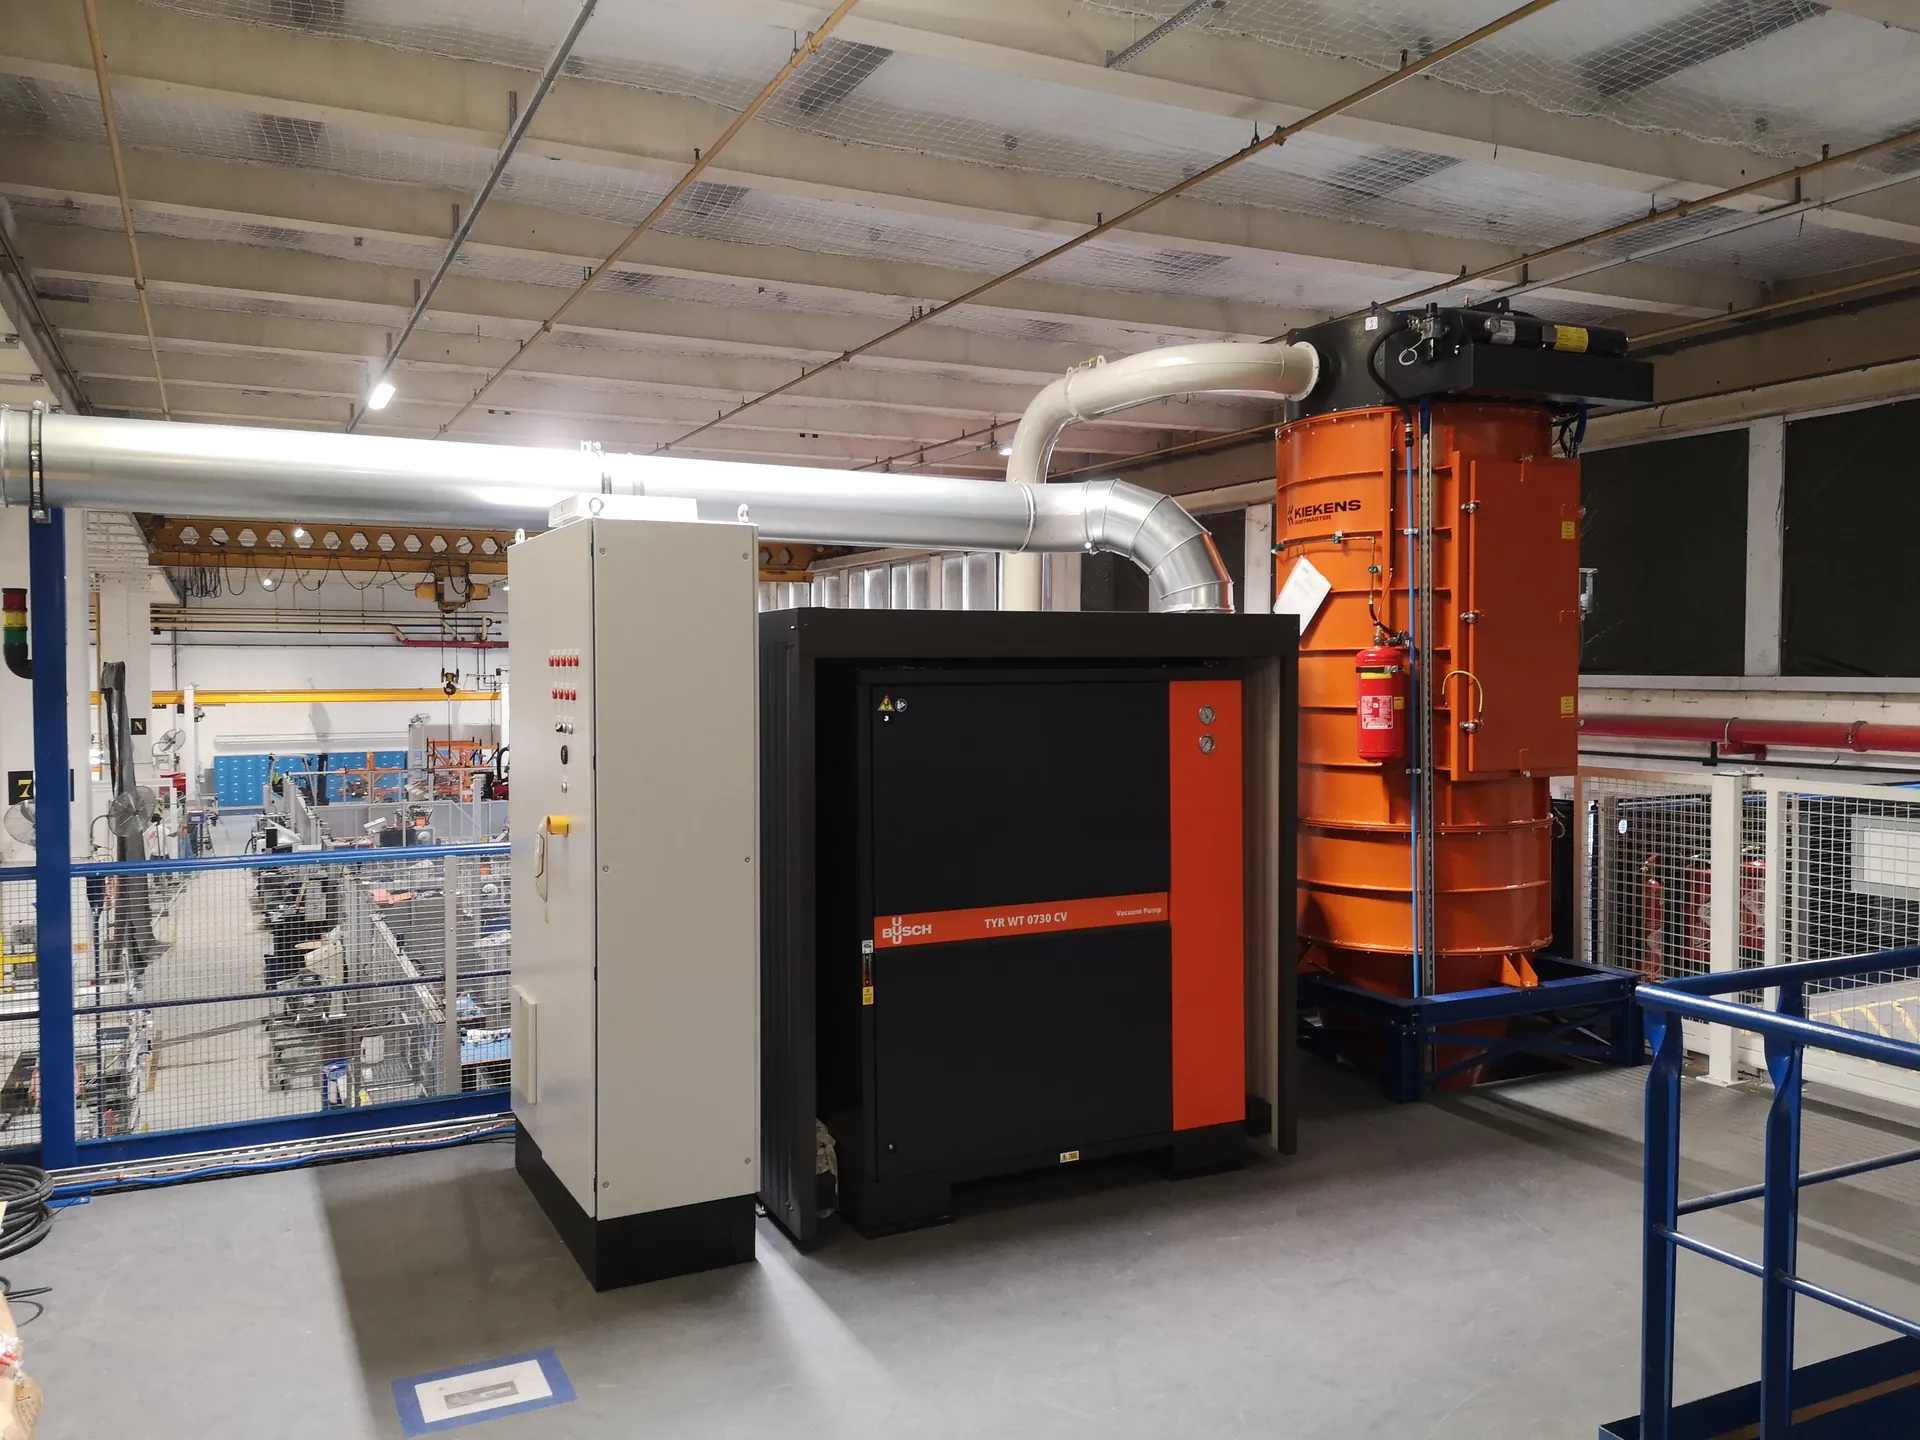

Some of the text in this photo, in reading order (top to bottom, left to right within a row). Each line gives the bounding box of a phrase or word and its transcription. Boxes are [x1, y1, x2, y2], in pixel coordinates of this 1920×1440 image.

[1294, 500, 1361, 519] KIEKENS
[134, 721, 143, 731] N
[18, 779, 33, 798] 7
[1116, 907, 1162, 917] Vacuum Pump
[984, 912, 1068, 929] TYR WT 0730 CV
[882, 923, 932, 939] BUSCH
